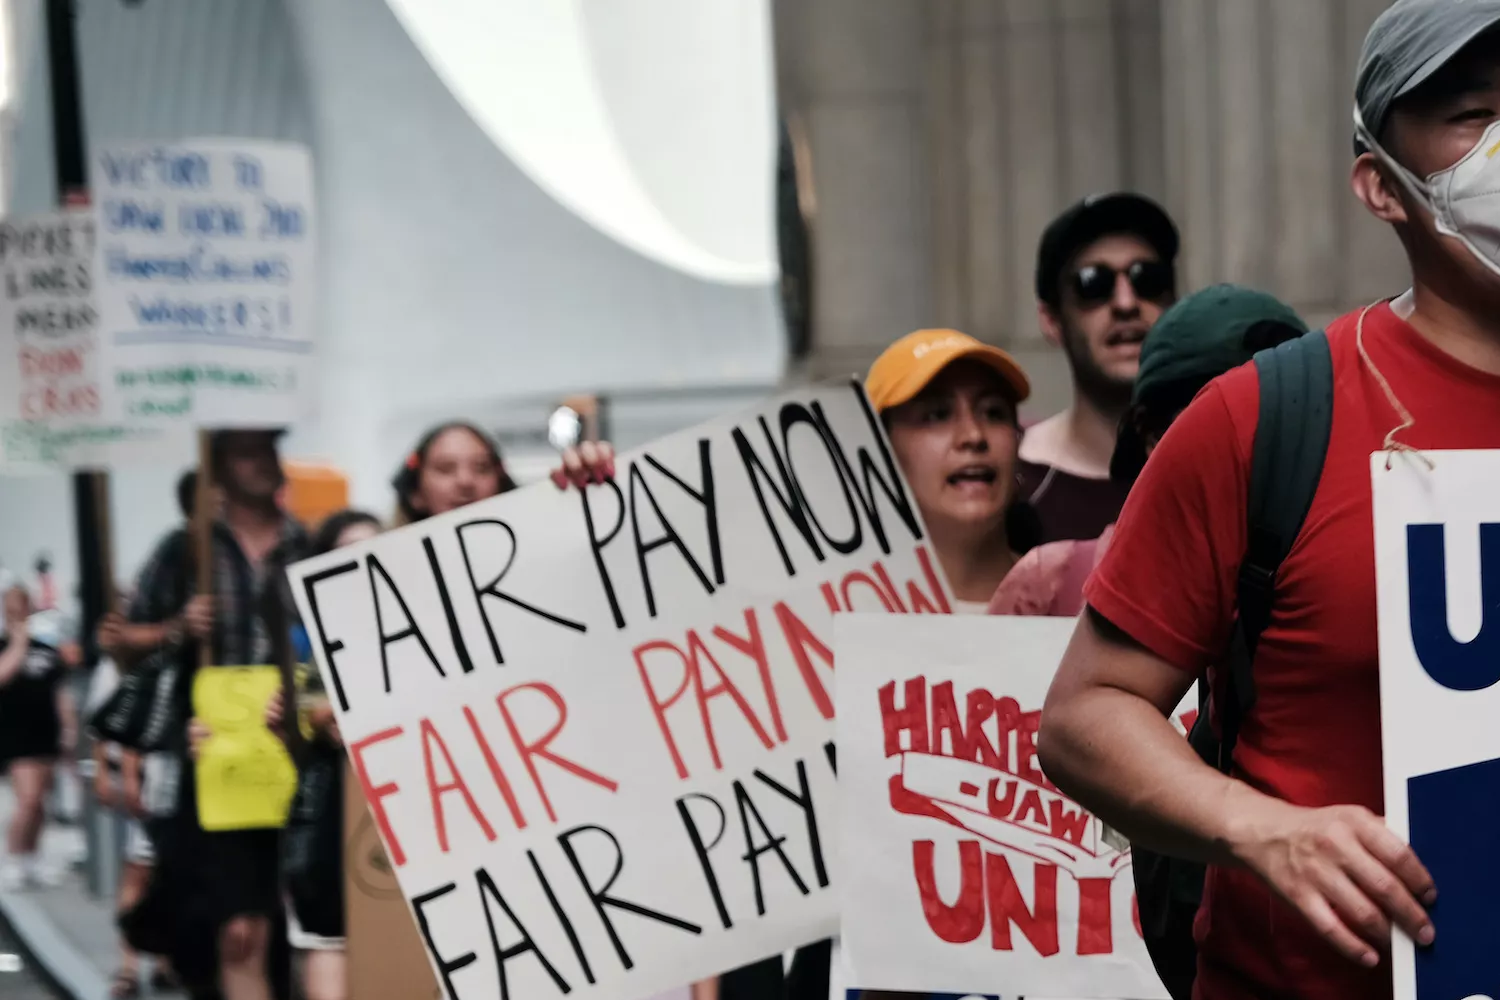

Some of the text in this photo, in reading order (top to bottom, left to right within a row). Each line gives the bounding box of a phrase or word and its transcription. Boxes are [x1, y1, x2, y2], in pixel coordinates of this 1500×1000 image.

[303, 519, 587, 711] FAIR
[580, 439, 725, 629] PAY
[731, 372, 923, 576] NOW
[350, 681, 618, 867] FAIR
[632, 607, 788, 780] PAY
[878, 675, 1062, 795] HARPE
[676, 760, 829, 928] PAY
[912, 840, 1143, 957] UNI
